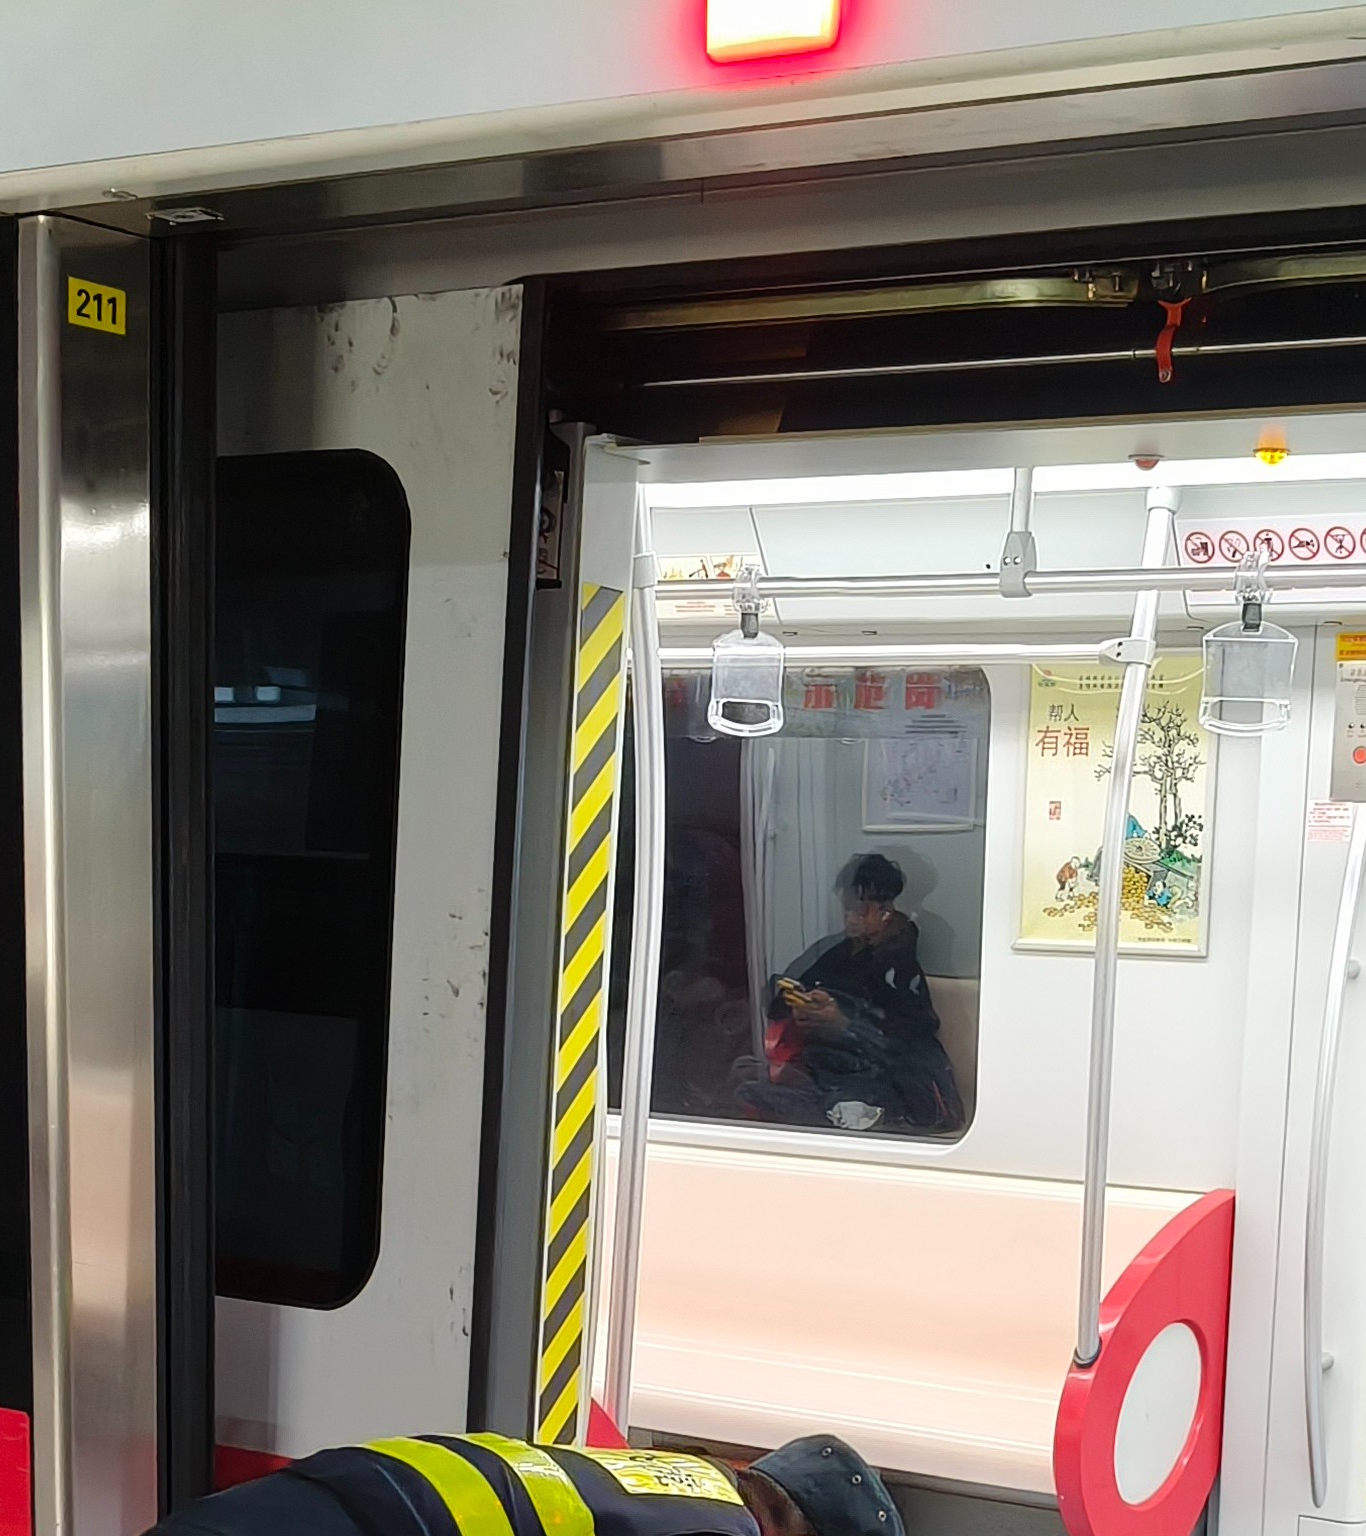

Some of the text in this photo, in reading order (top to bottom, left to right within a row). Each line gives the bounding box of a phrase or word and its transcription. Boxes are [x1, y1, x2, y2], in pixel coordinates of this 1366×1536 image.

[76, 288, 118, 326] 211
[1048, 703, 1080, 723] 帮人
[1035, 725, 1091, 758] 有福
